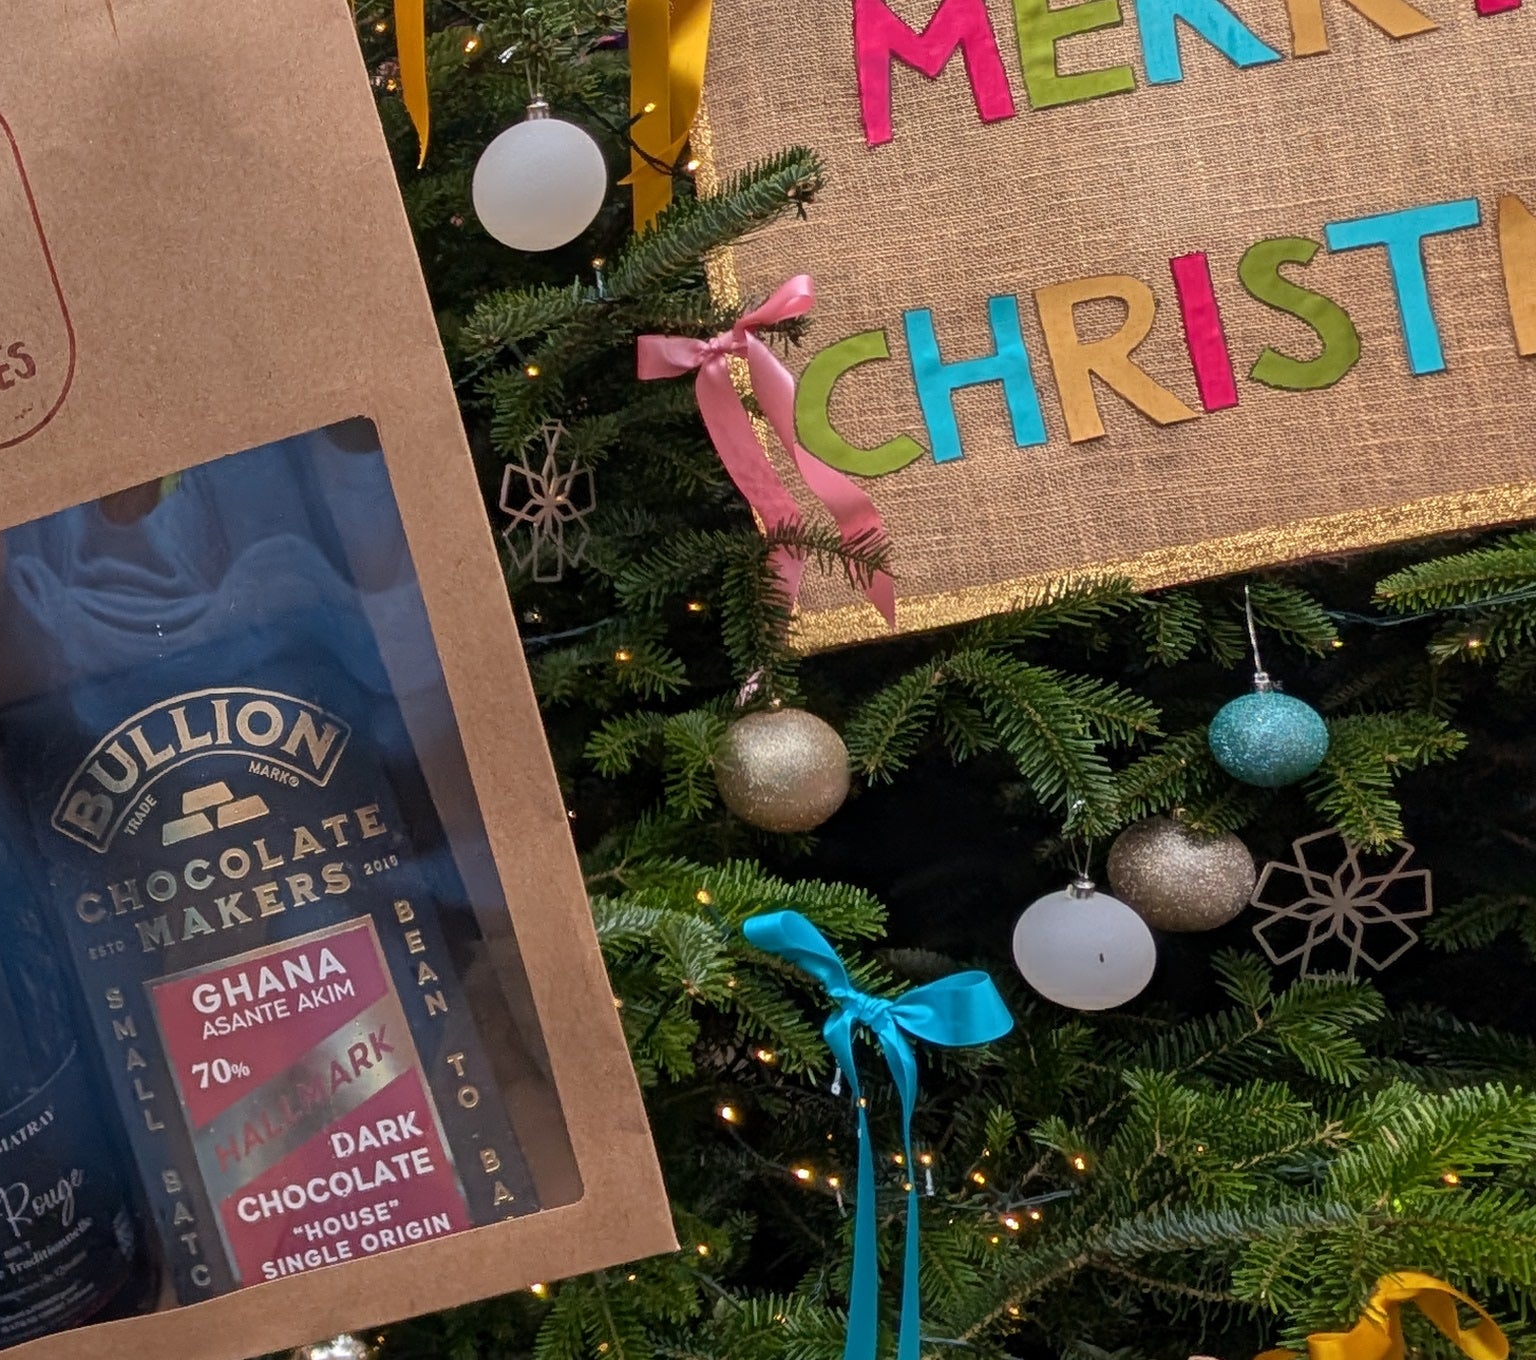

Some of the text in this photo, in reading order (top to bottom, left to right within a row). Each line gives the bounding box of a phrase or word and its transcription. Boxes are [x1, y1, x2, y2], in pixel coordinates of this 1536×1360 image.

[795, 191, 1536, 478] CHRIST
[63, 698, 342, 840] BULLION
[124, 793, 158, 837] TRADE
[75, 803, 388, 924] CHOCOLATE
[135, 862, 352, 954] MAKERS
[191, 946, 347, 1015] GHANA
[202, 978, 355, 1041] ASANTE AKIM
[105, 988, 166, 1132] SMALL
[191, 1057, 251, 1090] 70%
[215, 1023, 396, 1174] HALLMARK
[393, 899, 516, 1221] BEAN TO BA
[330, 1110, 424, 1159] DARK
[237, 1146, 435, 1223] CHOCOLATE
[261, 1212, 452, 1281] SINGLE ORIGIN
